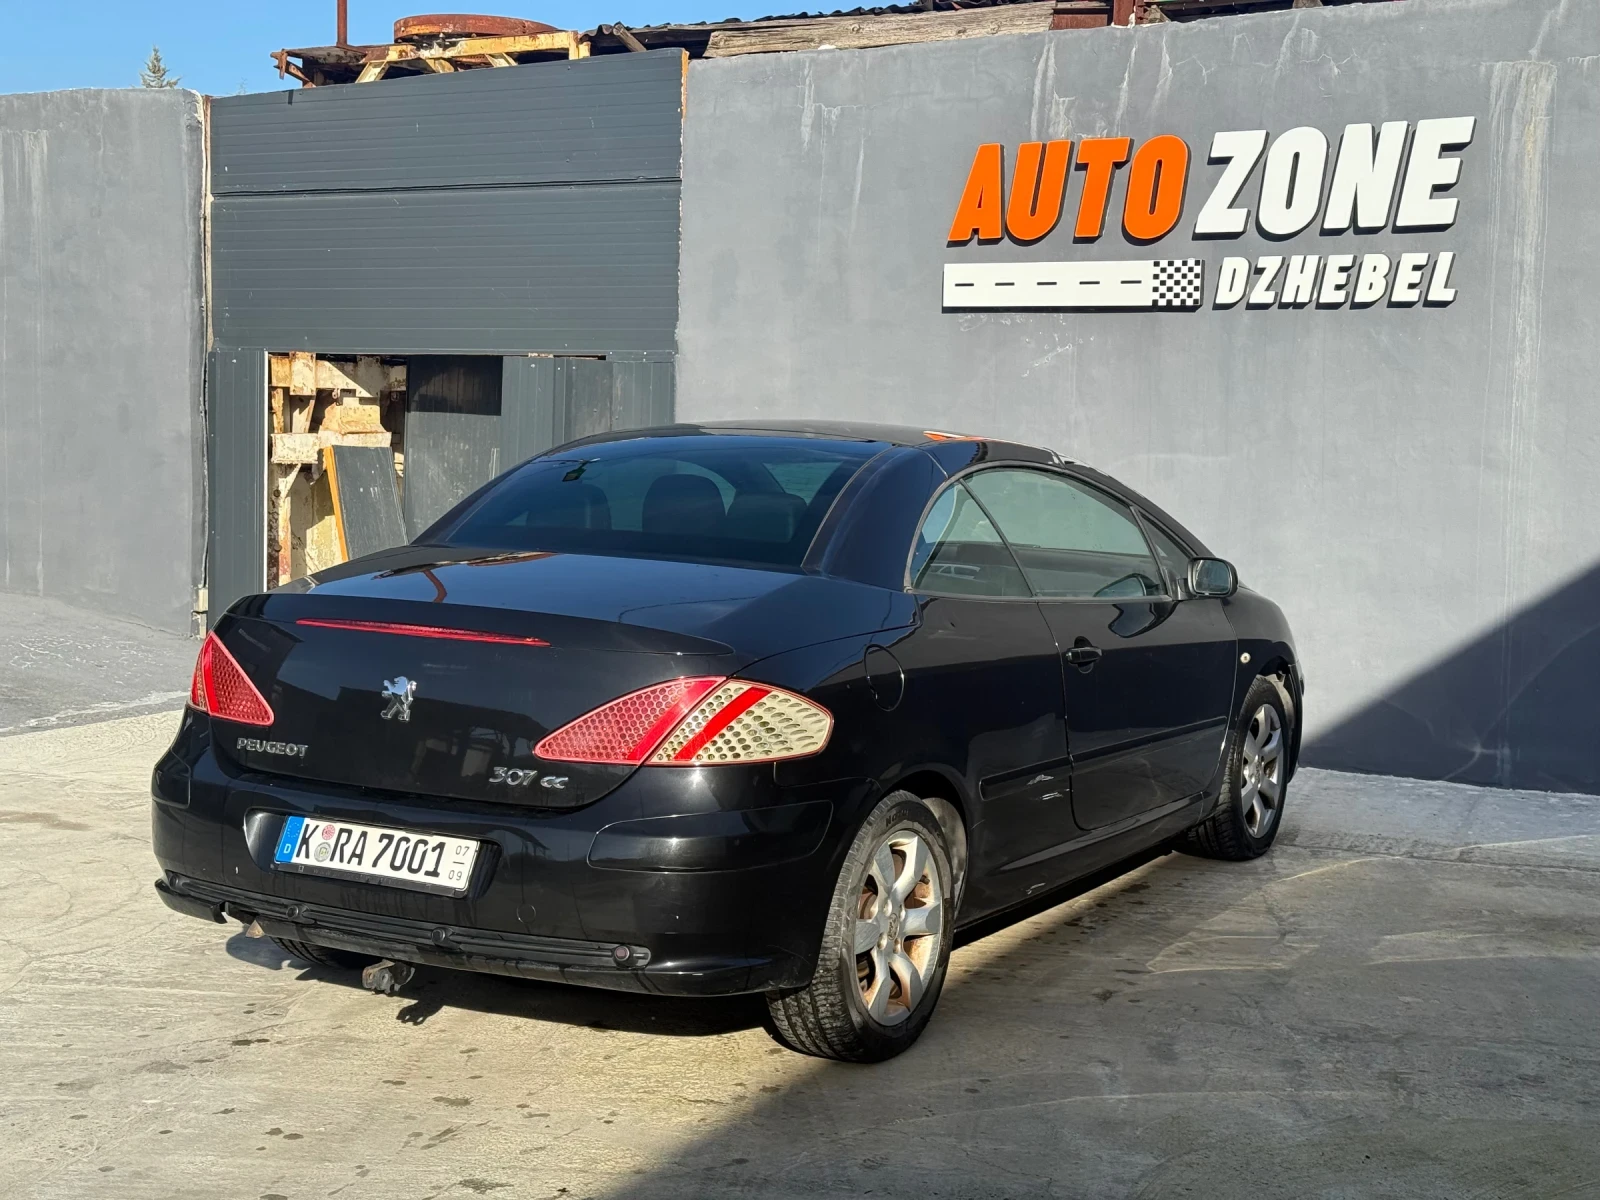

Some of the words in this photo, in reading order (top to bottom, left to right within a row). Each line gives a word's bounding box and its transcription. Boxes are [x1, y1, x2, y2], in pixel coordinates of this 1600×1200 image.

[947, 134, 1190, 241] AUTO
[1194, 116, 1476, 236] ZONE
[1214, 251, 1457, 304] DZHEBEL
[236, 737, 309, 757] PEUGEOT
[488, 766, 538, 786] 307
[283, 843, 292, 854] D
[295, 823, 320, 859] K
[329, 827, 368, 866] RA
[371, 832, 446, 878] 7001
[455, 844, 470, 857] 07
[448, 869, 463, 881] 09
